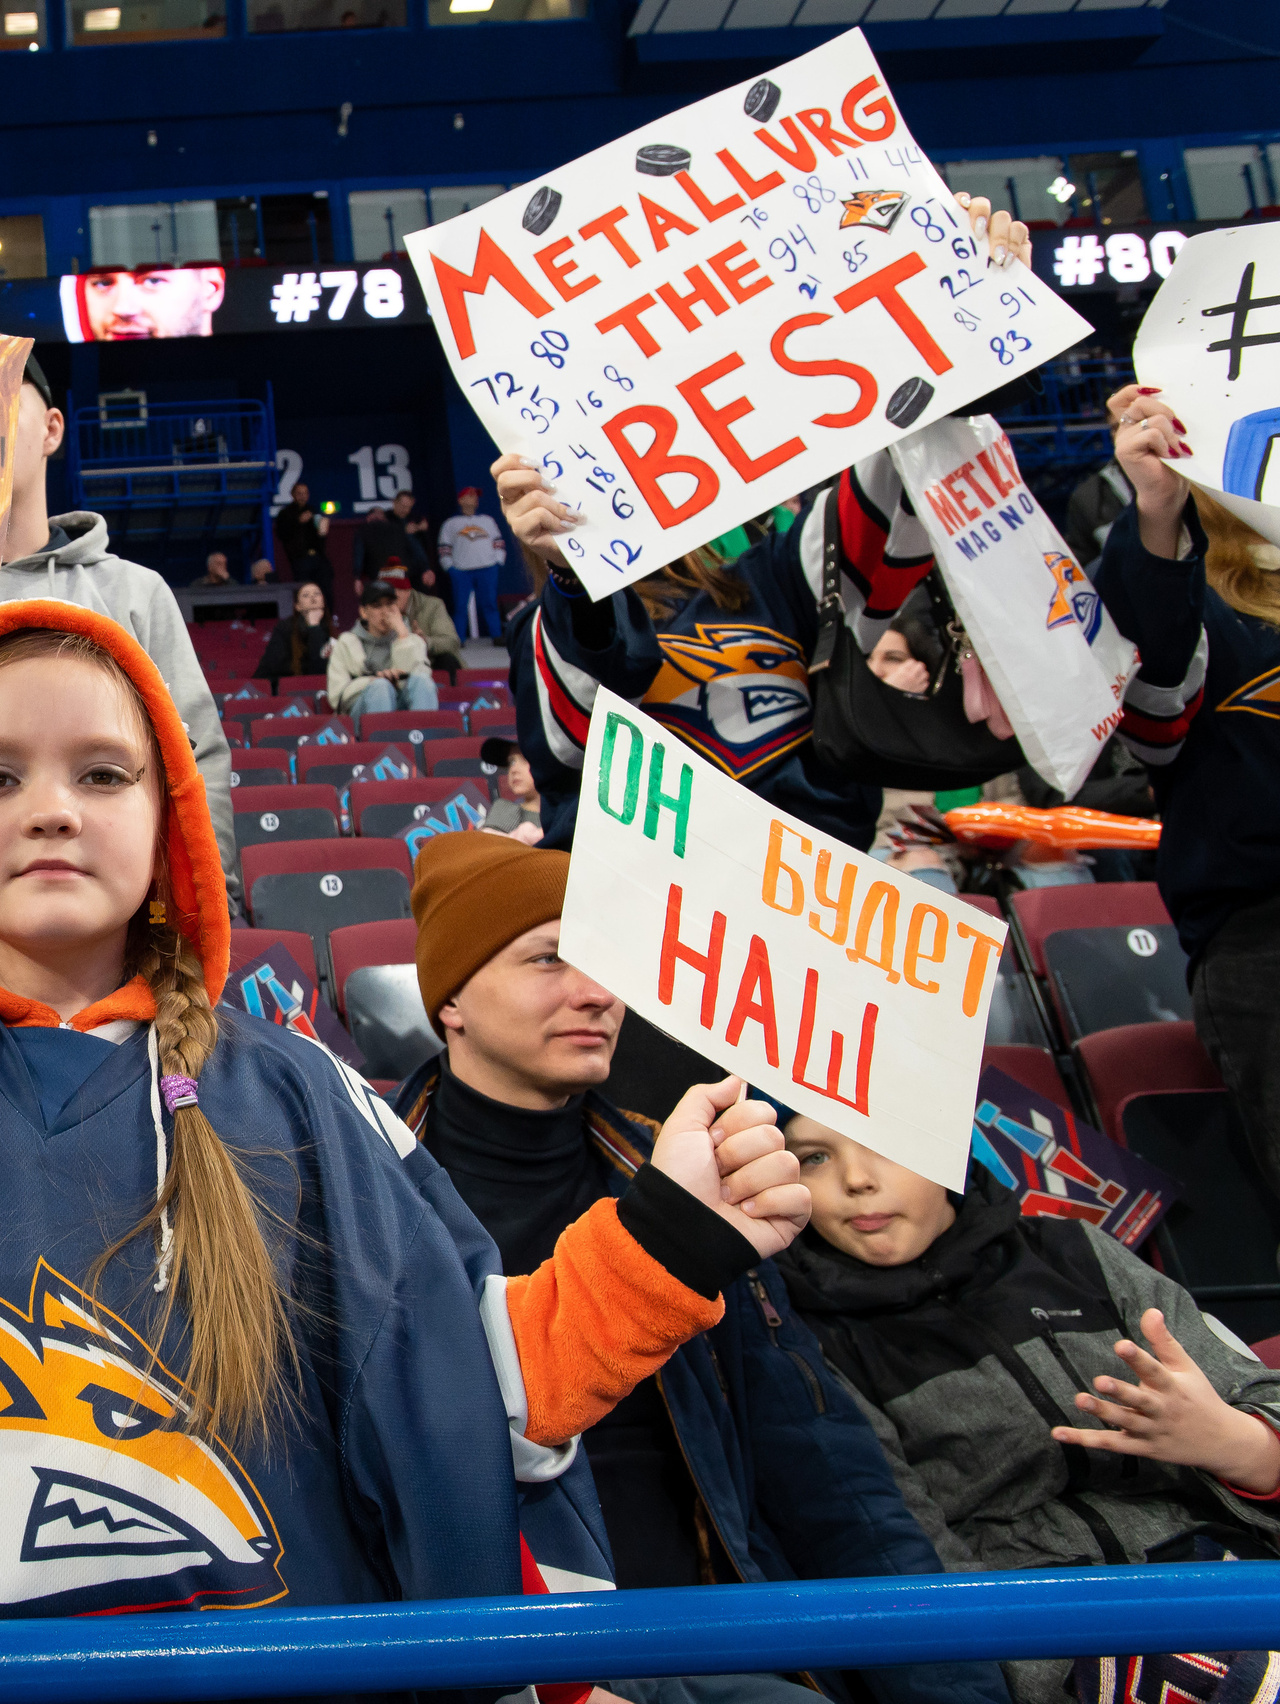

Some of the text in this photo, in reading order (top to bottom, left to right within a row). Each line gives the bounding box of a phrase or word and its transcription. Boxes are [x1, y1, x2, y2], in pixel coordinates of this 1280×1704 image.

[792, 175, 836, 214] 88
[740, 206, 769, 230] 76
[769, 223, 816, 273] 94
[842, 239, 869, 273] 85
[1052, 230, 1188, 286] #80
[271, 268, 405, 324] #78
[595, 240, 775, 359] THE
[939, 268, 985, 299] 22
[999, 286, 1037, 319] 91
[530, 330, 570, 370] 80
[989, 330, 1033, 366] 83
[470, 371, 524, 406] 72
[601, 251, 954, 530] BEST
[348, 443, 413, 501] 13
[600, 539, 643, 574] 12
[598, 711, 694, 859] ОН
[658, 882, 879, 1117] НАШ
